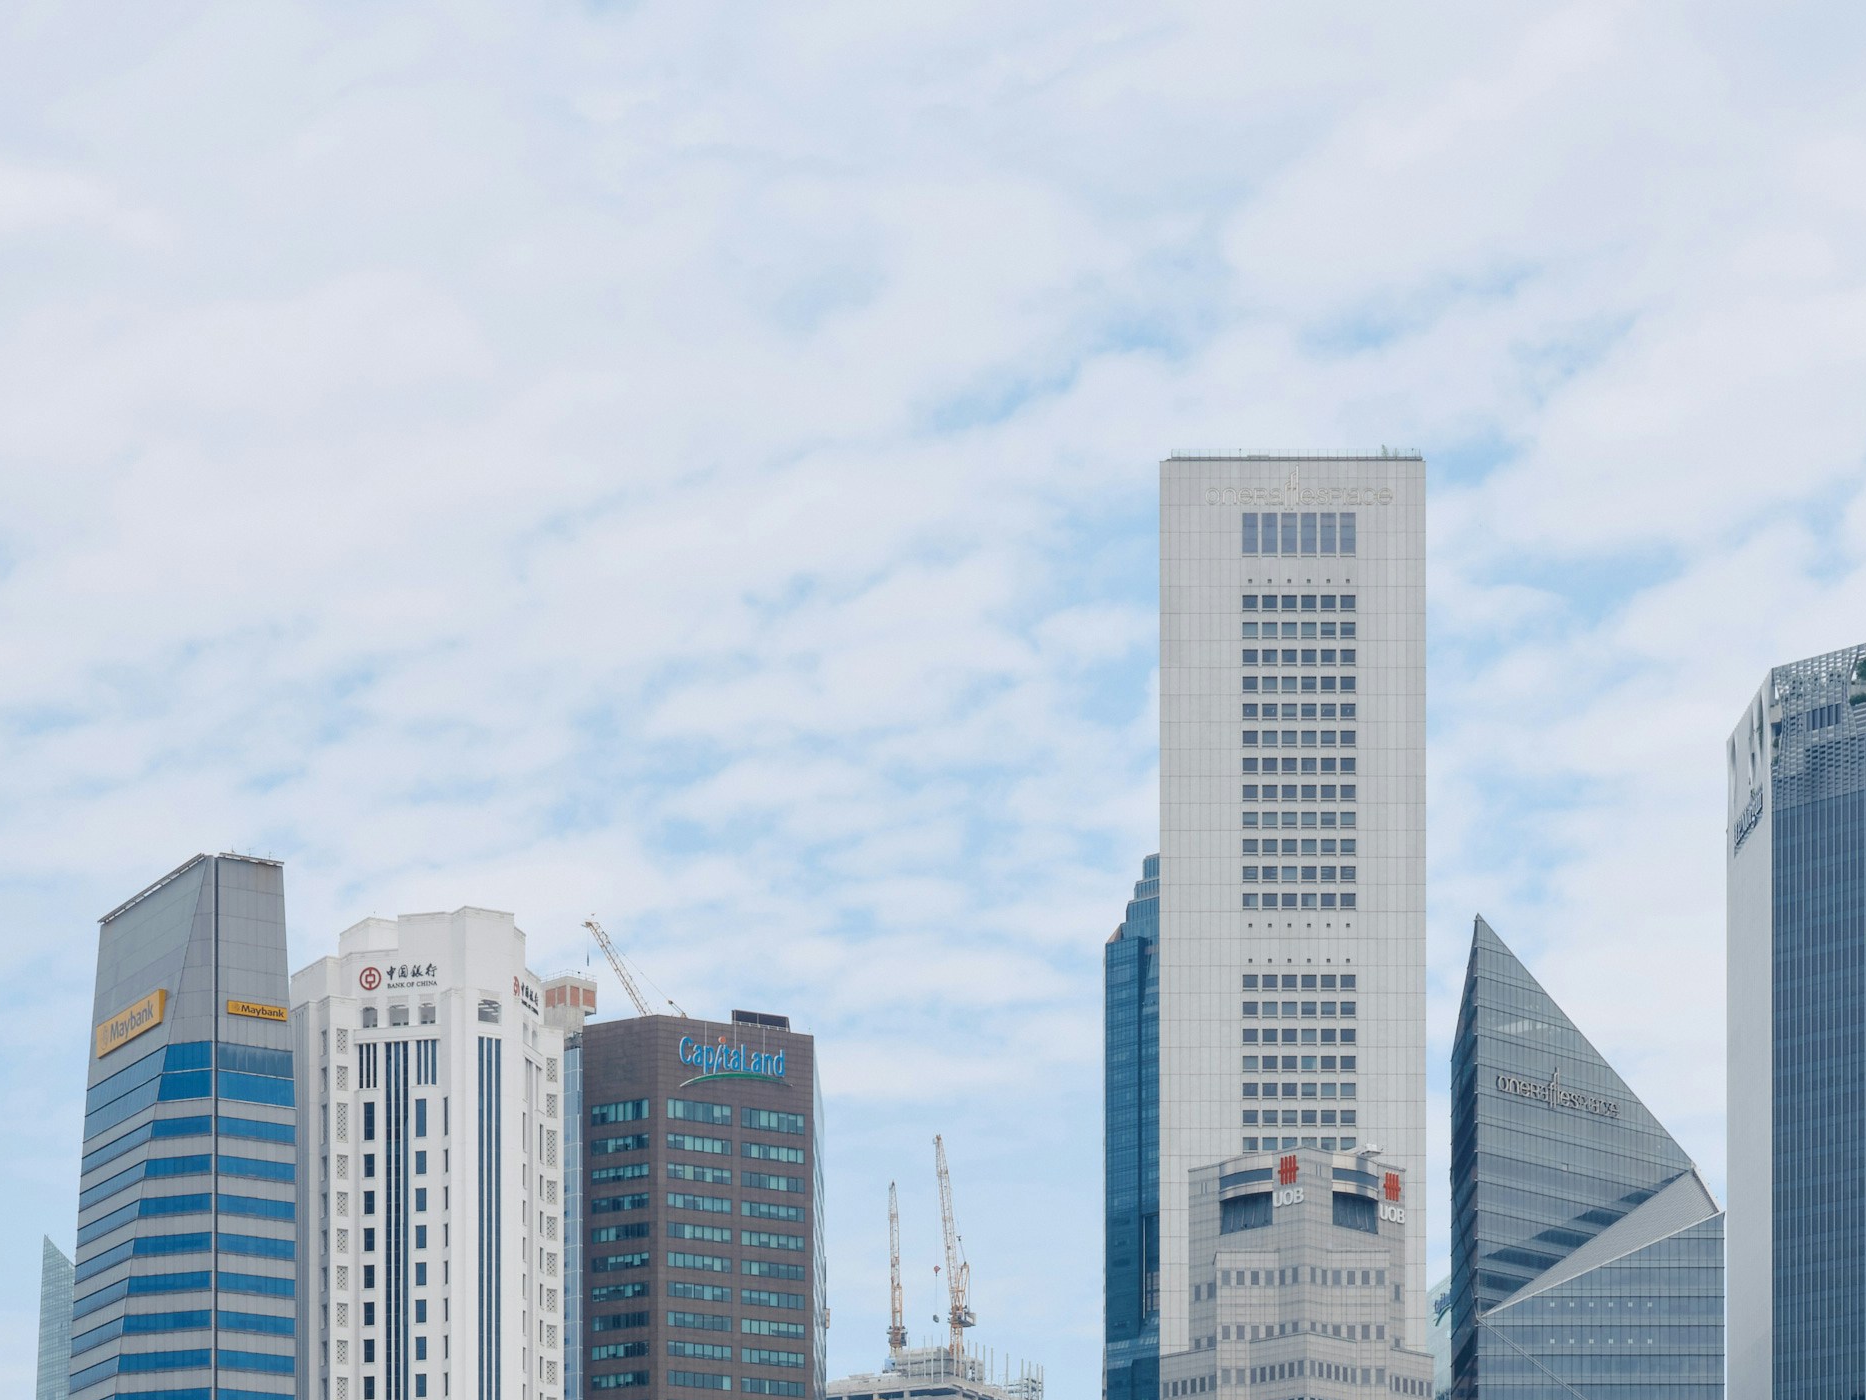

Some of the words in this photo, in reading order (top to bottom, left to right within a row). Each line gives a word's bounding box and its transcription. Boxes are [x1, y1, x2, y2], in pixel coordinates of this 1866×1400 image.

[408, 980, 416, 988] OF
[417, 979, 438, 987] CHINA
[241, 1003, 284, 1019] Maybank
[109, 1004, 154, 1043] Maybank
[679, 1036, 786, 1077] CapitaLand
[1272, 1187, 1304, 1208] UOB
[1378, 1204, 1405, 1224] UOB
